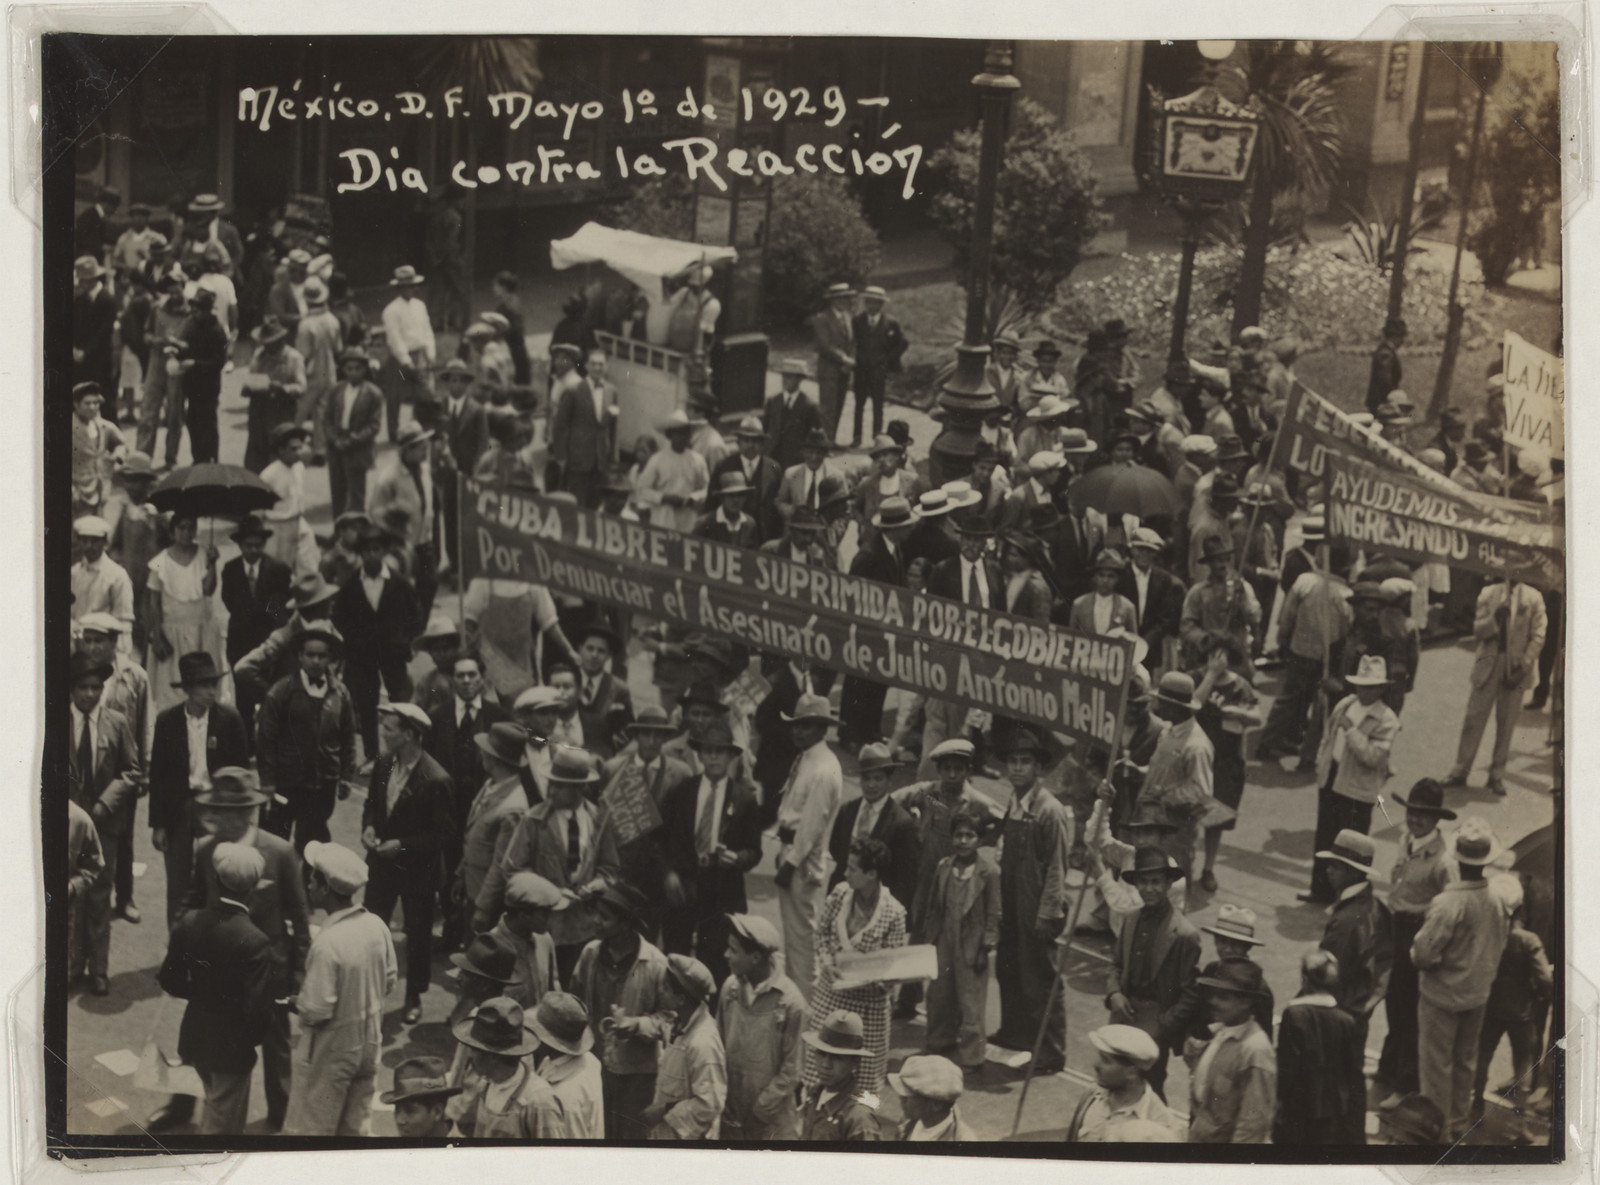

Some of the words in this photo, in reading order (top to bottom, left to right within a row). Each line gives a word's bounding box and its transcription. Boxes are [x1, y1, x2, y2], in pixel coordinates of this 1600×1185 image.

[1328, 500, 1469, 560] INGRESANDO
[1329, 469, 1460, 526] AYUDEMOS
[683, 538, 743, 585] FUE
[754, 555, 904, 628] SUPRIMIDA
[477, 526, 523, 574] Por
[532, 540, 654, 610] Denunciar
[663, 578, 687, 620] el
[700, 584, 832, 662] Asesinato
[843, 623, 872, 672] de
[876, 632, 947, 692] Julio
[956, 653, 1058, 722] Antonio
